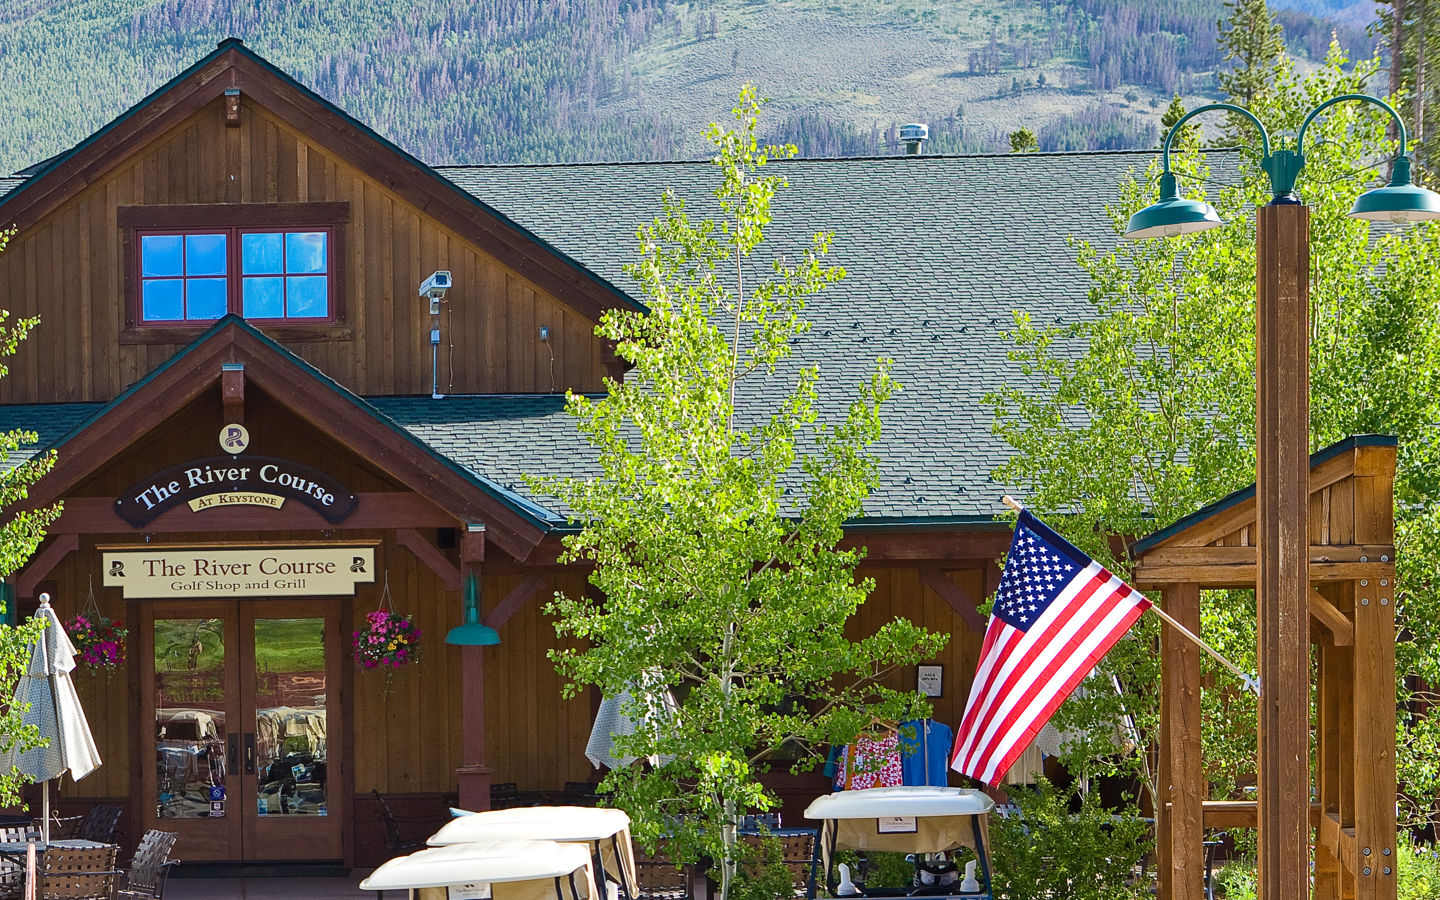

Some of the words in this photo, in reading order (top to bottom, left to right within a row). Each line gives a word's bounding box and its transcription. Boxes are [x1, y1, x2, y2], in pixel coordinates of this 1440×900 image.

[135, 480, 181, 511] The
[185, 465, 251, 489] River
[259, 464, 335, 506] Course
[142, 558, 186, 577] The
[193, 558, 252, 577] River
[259, 557, 337, 576] Course
[170, 580, 204, 591] Golf
[206, 580, 241, 592] Shop
[245, 579, 270, 590] and
[274, 578, 307, 589] Grill
